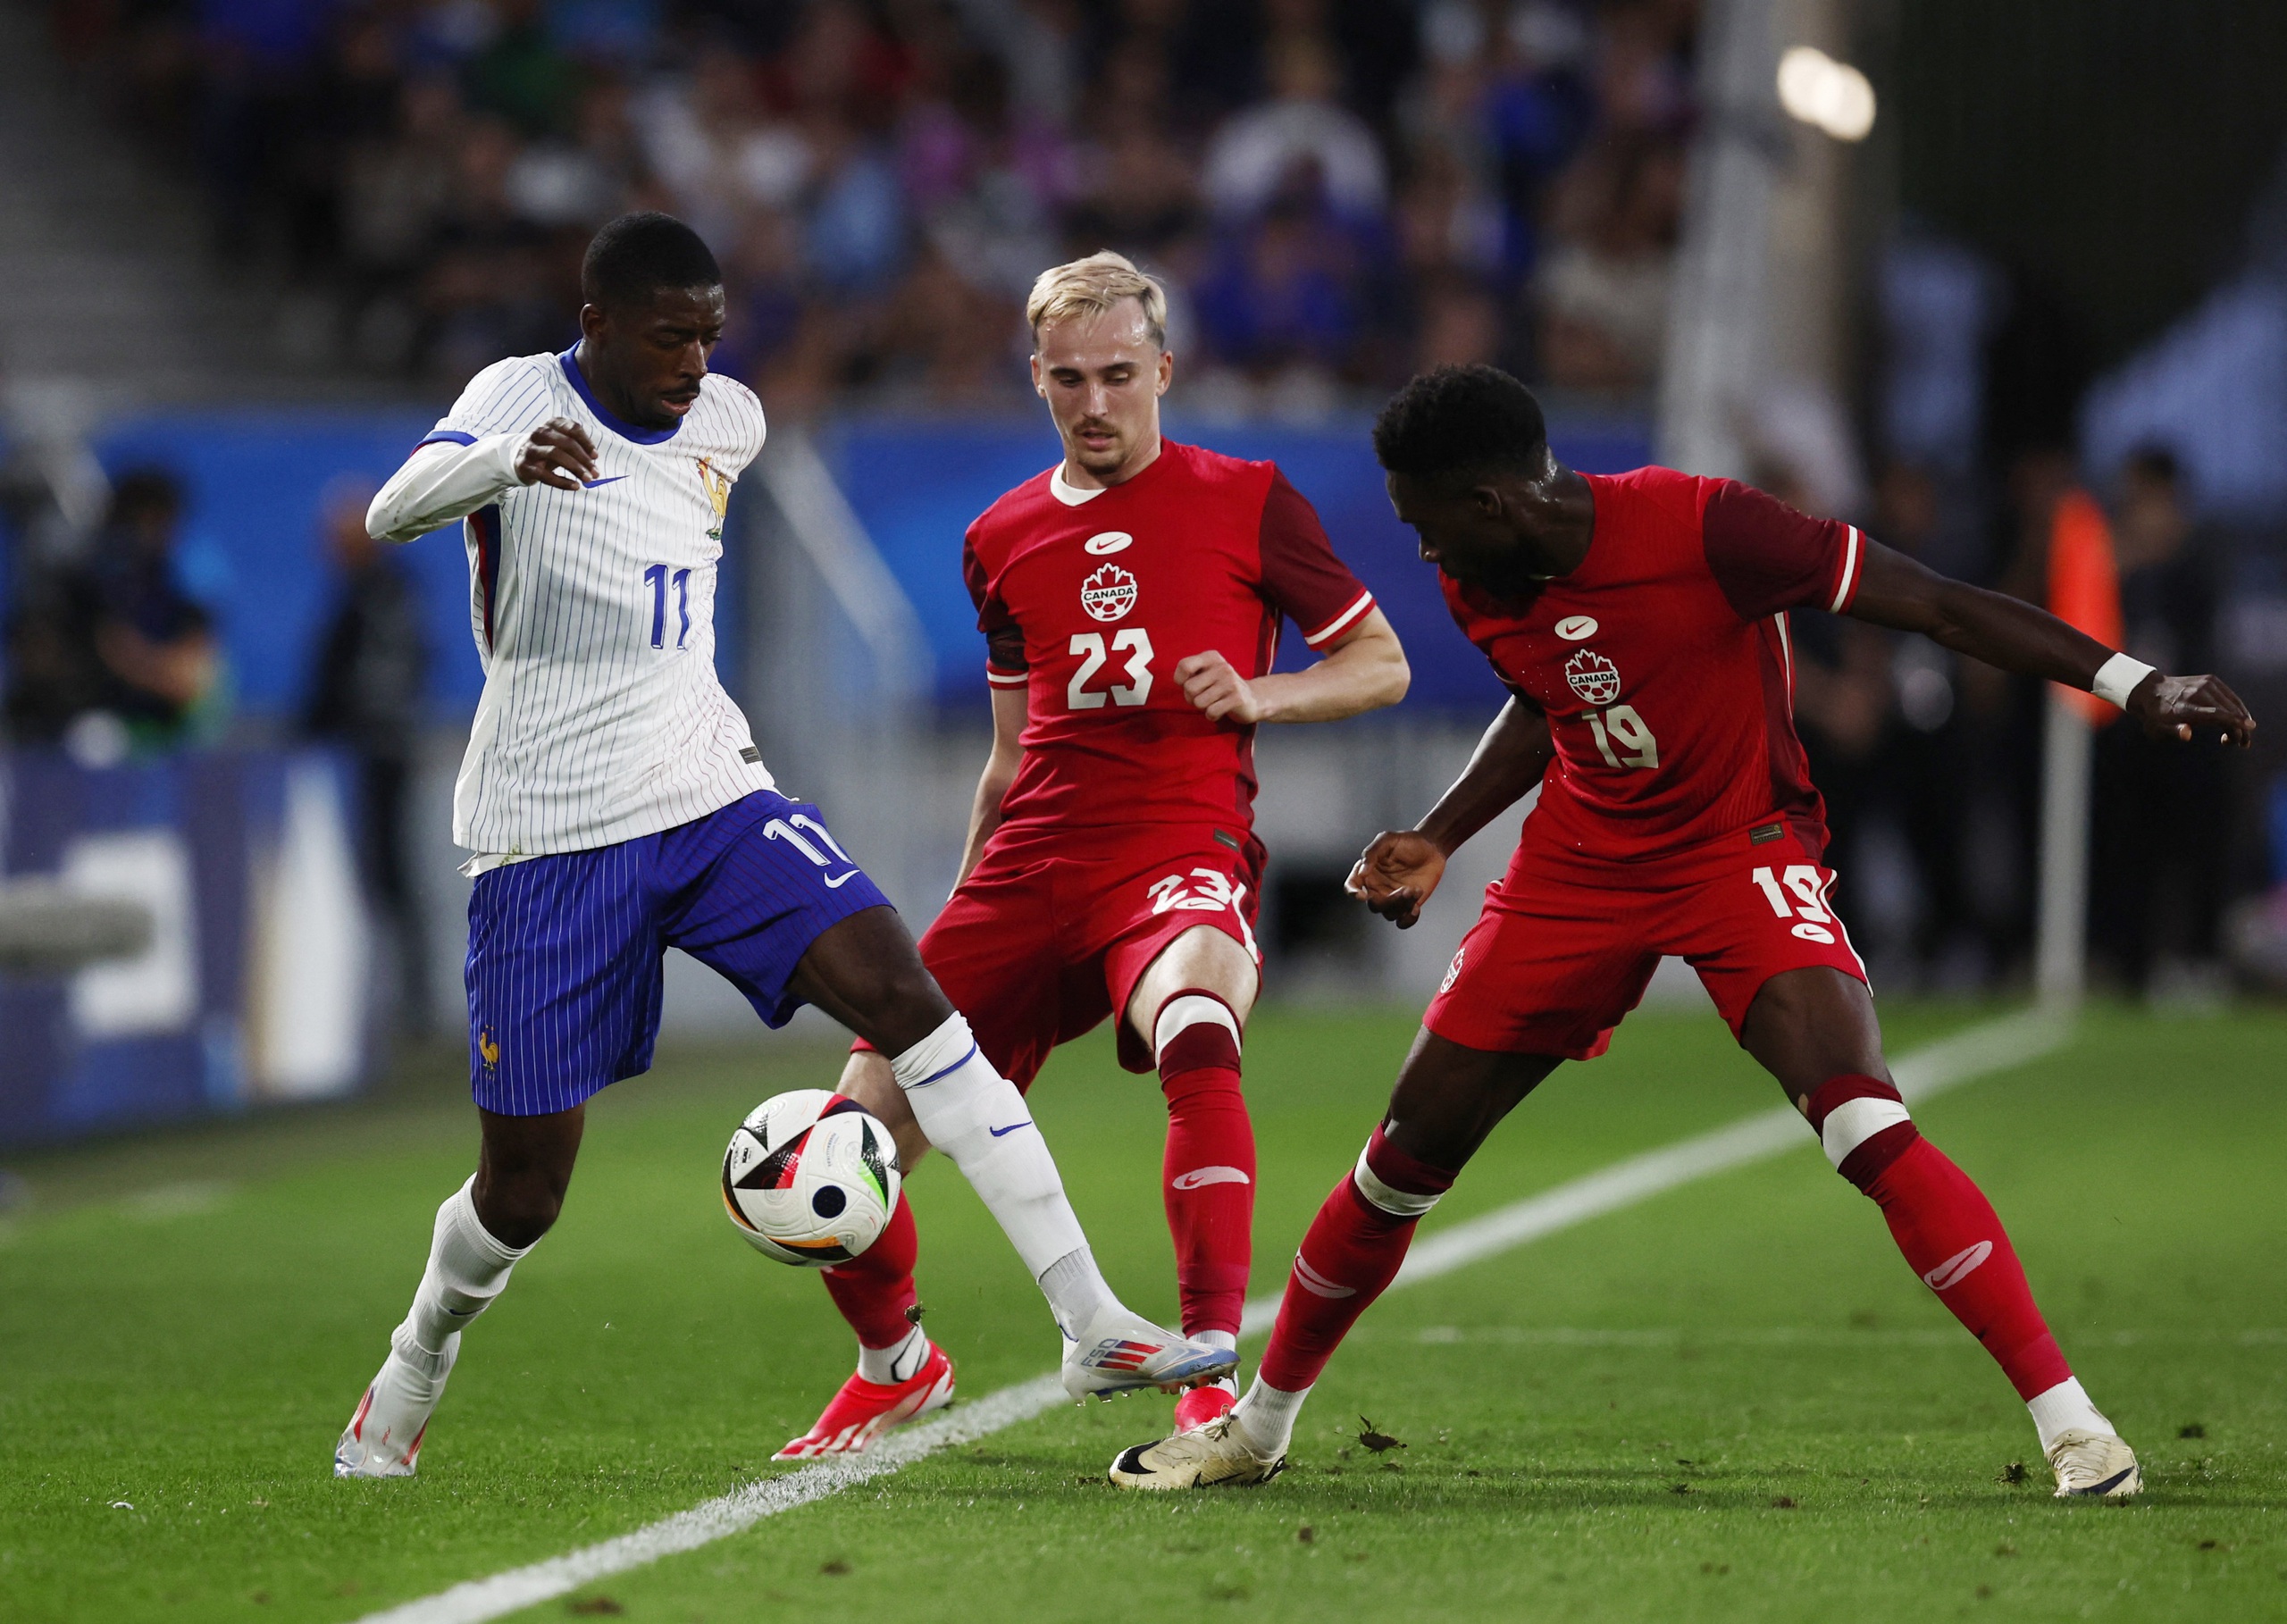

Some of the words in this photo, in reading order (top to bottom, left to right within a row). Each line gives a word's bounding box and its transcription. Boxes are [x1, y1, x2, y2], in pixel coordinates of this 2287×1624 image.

[644, 564, 691, 650] 11
[1084, 587, 1135, 601] CANADA
[1067, 627, 1155, 709] 23
[1569, 672, 1617, 685] CANADA
[1581, 705, 1659, 769] 19
[762, 814, 854, 866] 11
[1146, 867, 1233, 916] 23
[1752, 865, 1831, 924] 19
